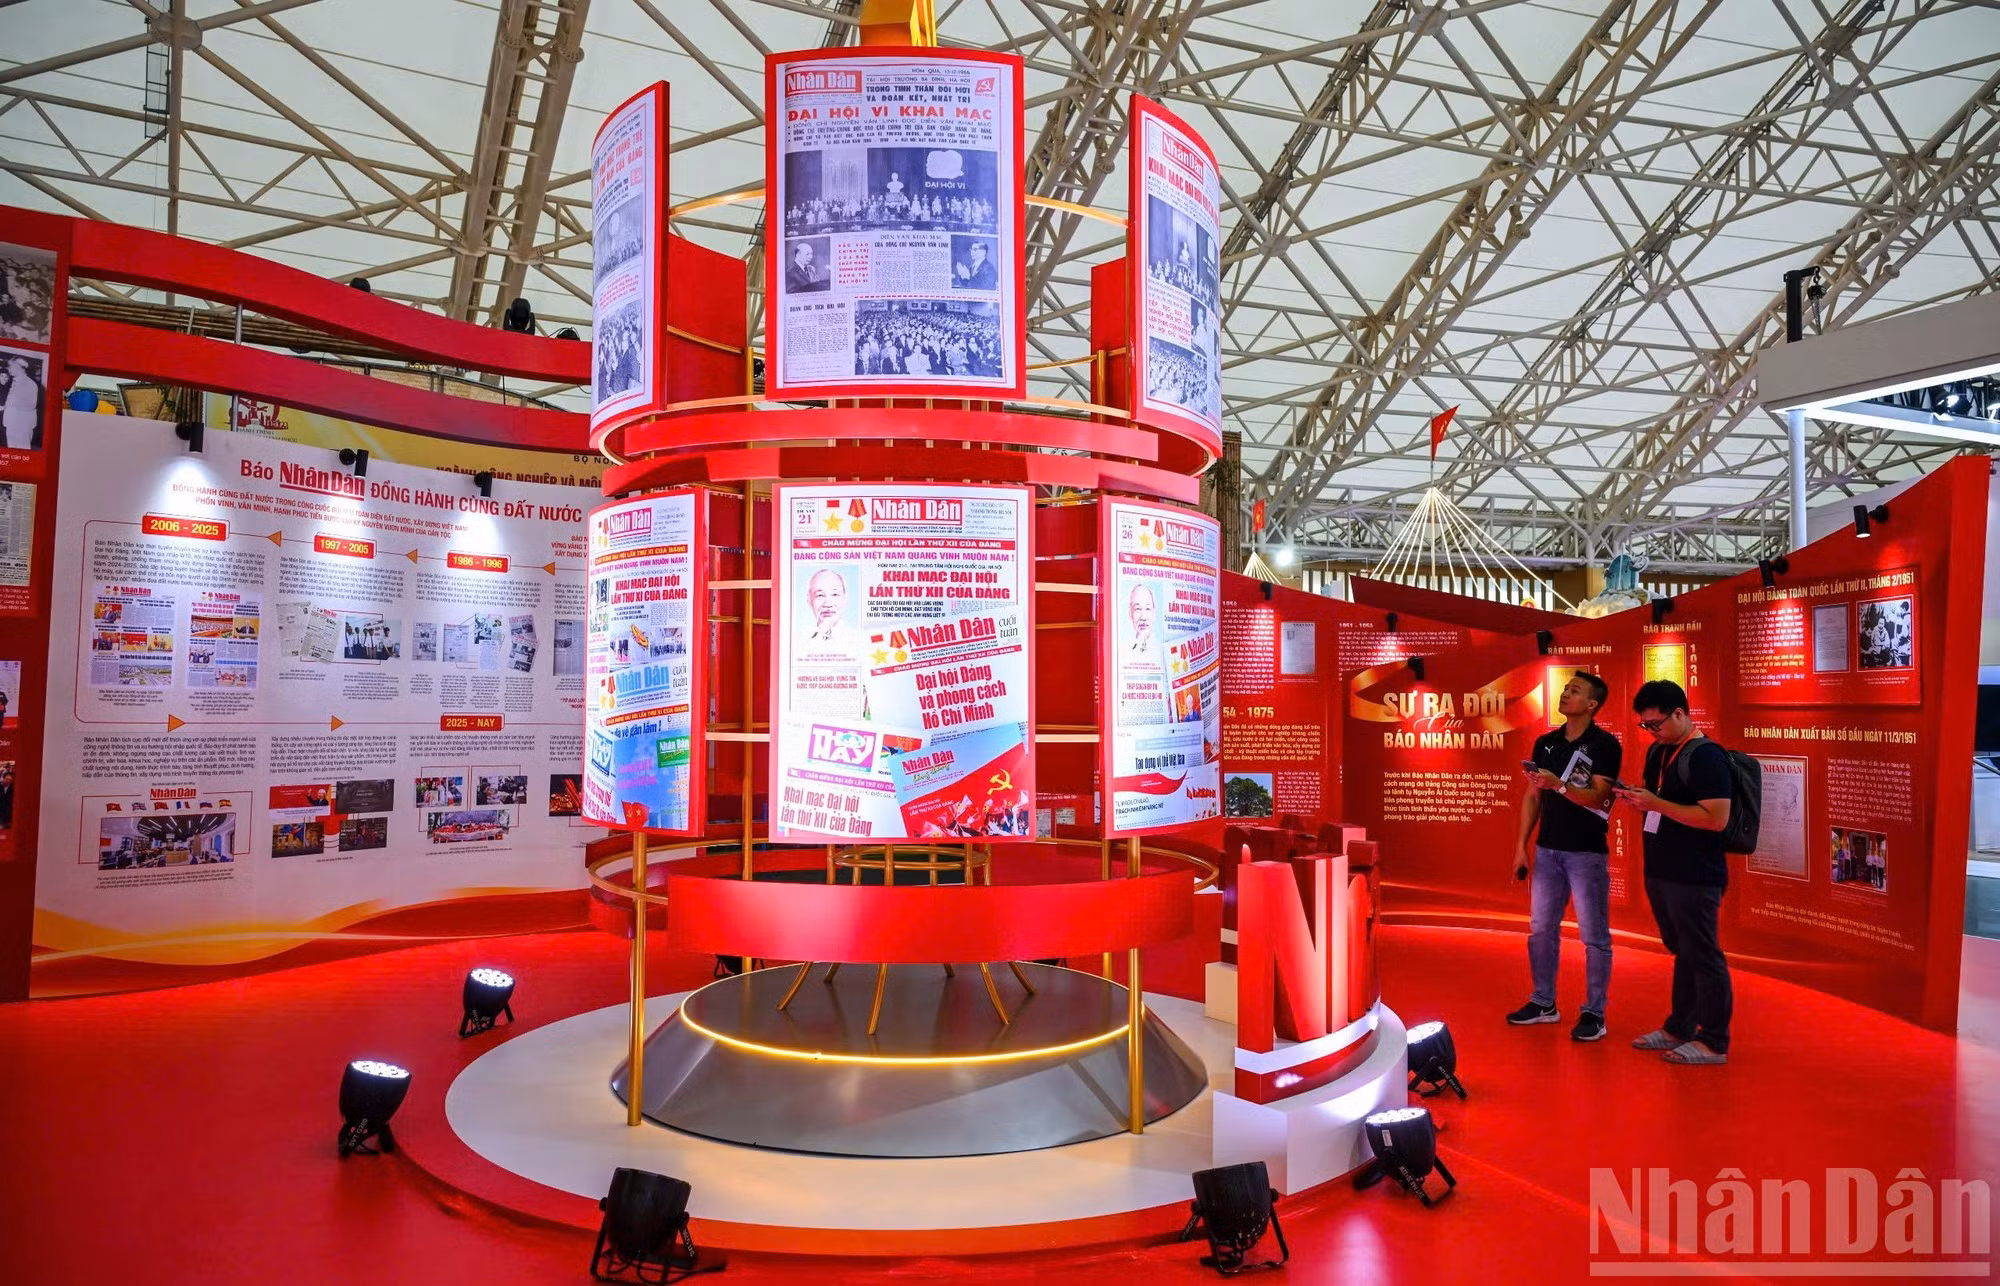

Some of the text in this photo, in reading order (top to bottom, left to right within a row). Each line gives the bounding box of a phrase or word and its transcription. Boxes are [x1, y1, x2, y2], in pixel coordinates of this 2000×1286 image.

[787, 72, 856, 91] Nhân Dân
[788, 106, 992, 122] ĐẠI HỘI VI KHAI MẠC
[1164, 136, 1203, 178] Nhân Dân
[241, 459, 582, 522] Báo Nhân Dân ĐỒNG HÀNH CÙNG ĐẤT NƯỚC
[799, 514, 811, 524] 21
[873, 500, 920, 520] Nhân
[926, 500, 960, 520] Dân
[150, 519, 219, 536] 2006 2025
[611, 511, 650, 533] Nhân Dân
[1122, 530, 1133, 539] 26
[1168, 524, 1189, 544] Nhân
[321, 539, 369, 554] 1997 2005
[794, 551, 816, 560] ĐẢNG
[819, 551, 841, 560] CỘNG
[844, 551, 860, 559] SẢN
[864, 551, 882, 560] VIỆT
[908, 552, 937, 560] QUANG
[940, 552, 960, 560] VINH
[963, 552, 987, 560] MUÔN
[990, 552, 1009, 561] NĂM
[453, 556, 502, 568] 1986 1996
[616, 574, 680, 591] KHAI MẠC ĐẠI HỘI
[883, 571, 997, 585] KHAI MẠC ĐẠI HỘI
[636, 591, 643, 602] XI
[645, 587, 661, 601] CỦA
[662, 588, 687, 600] ĐẢNG
[869, 583, 1010, 599] LẦN THỨ XII CỦA ĐẢNG
[1738, 593, 1751, 605] ĐẠI
[1753, 591, 1765, 603] HỘI
[1766, 588, 1787, 600] ĐẢNG
[1789, 585, 1808, 598] TOÀN
[1810, 581, 1829, 596] QUỐC
[1830, 581, 1844, 594] LẦN
[1846, 579, 1859, 592] THỨ
[1868, 576, 1890, 590] THÁNG
[1892, 572, 1914, 586] 2/1951
[998, 614, 1016, 627] cuối
[907, 617, 996, 648] Nhân Dân
[1000, 626, 1018, 639] tuần
[1566, 646, 1591, 654] THANH
[616, 665, 669, 694] Nhân Dân
[915, 664, 992, 692] Đại hội Đảng
[919, 680, 1007, 709] và phong cách
[1383, 688, 1505, 719] SỰ RA ĐỜI
[922, 702, 994, 730] Hồ Chí Minh
[1223, 707, 1274, 718] 54 1975
[1413, 711, 1464, 730] Của
[446, 718, 495, 728] 2025 NAY
[1383, 729, 1504, 750] BÁO NHÂN DÂN
[1744, 725, 1759, 737] BÁO
[1761, 726, 1782, 738] NHÂN
[1784, 726, 1799, 739] DÂN
[1801, 726, 1820, 740] XUẤT
[1821, 726, 1836, 741] BẢN
[1837, 727, 1847, 741] SỐ
[1864, 729, 1883, 743] NGÀY
[1884, 730, 1916, 744] 11/3/1951
[902, 750, 954, 775] Nhân Dân
[150, 788, 196, 798] Nhân Dân
[784, 786, 860, 816] Khai mạc Đại hội
[781, 803, 872, 837] lần thứ XII của Đảng
